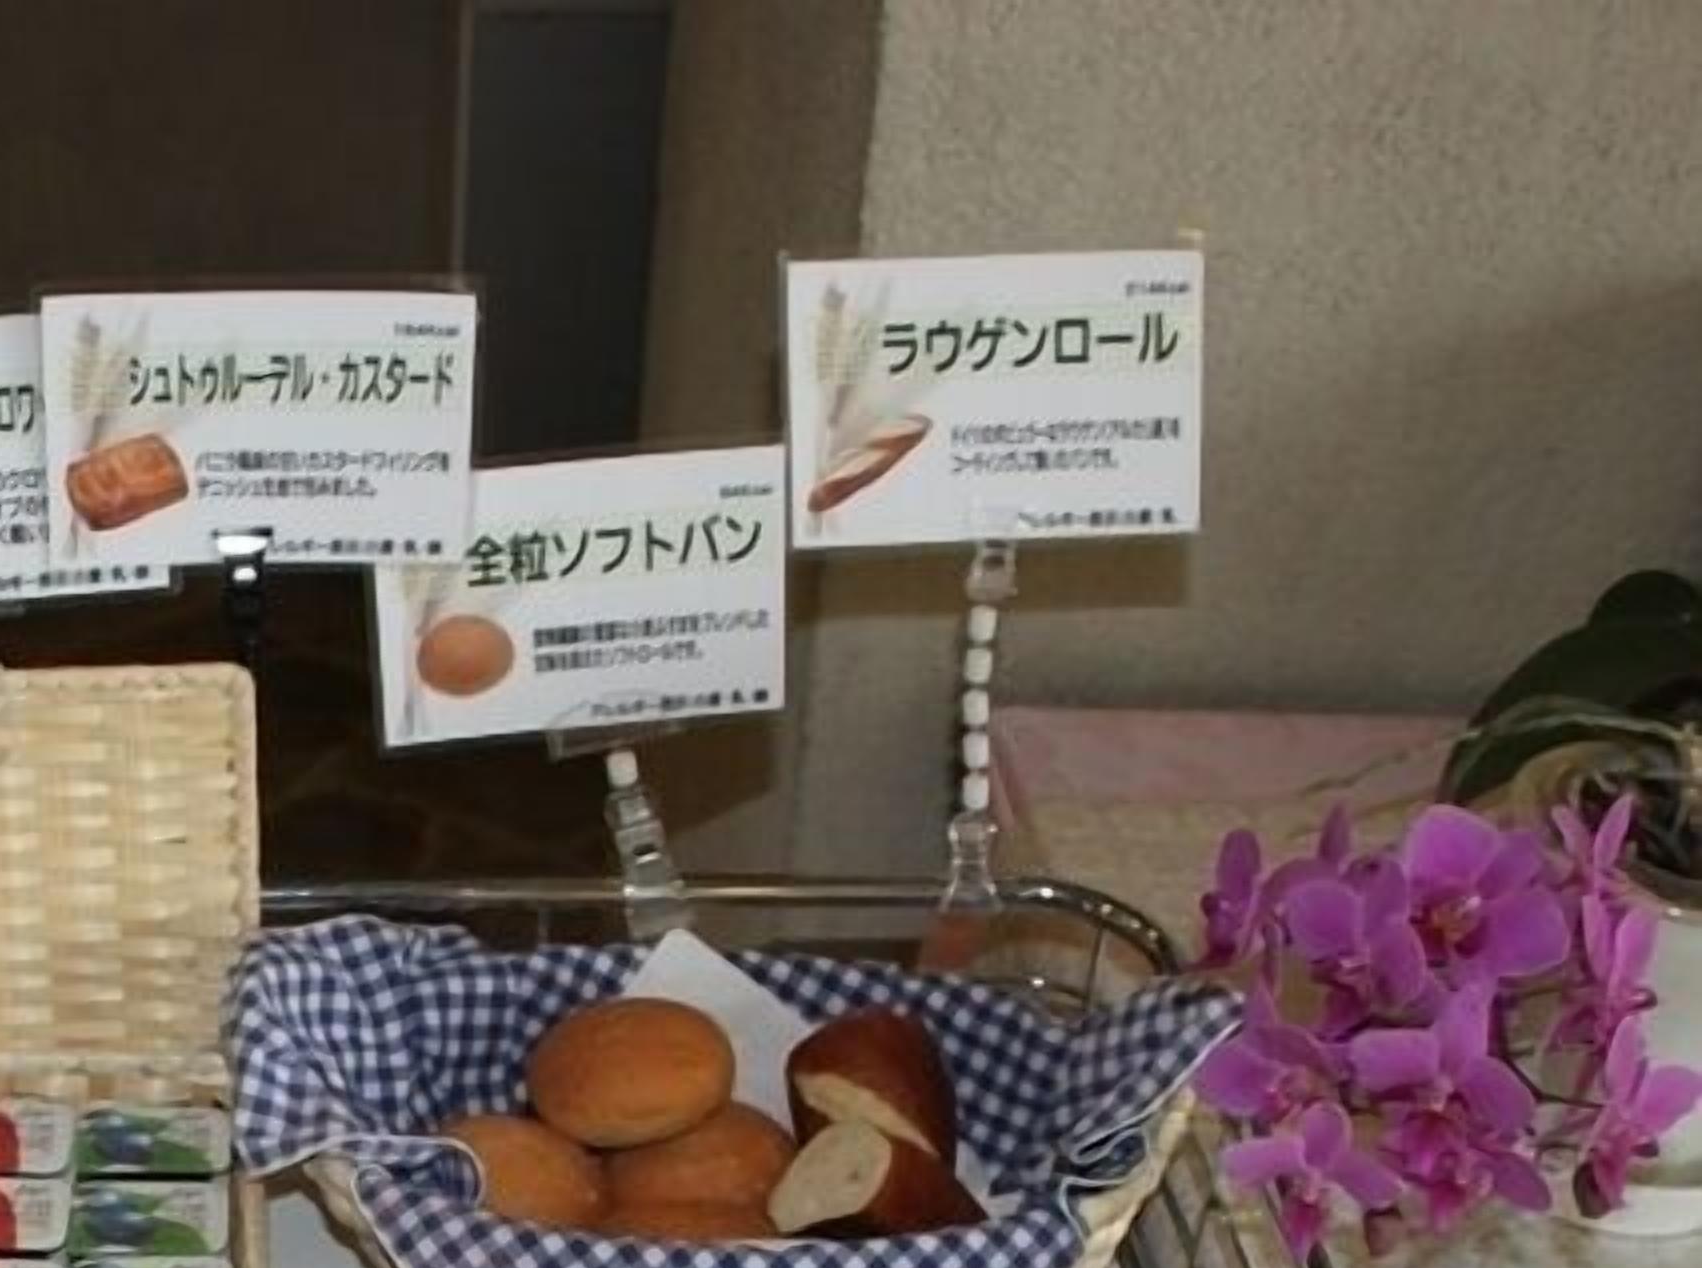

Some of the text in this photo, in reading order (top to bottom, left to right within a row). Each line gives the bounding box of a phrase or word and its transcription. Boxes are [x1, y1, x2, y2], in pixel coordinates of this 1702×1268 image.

[882, 313, 1179, 374] ラウゲンロール
[466, 514, 763, 588] 全粒ソフトパン
